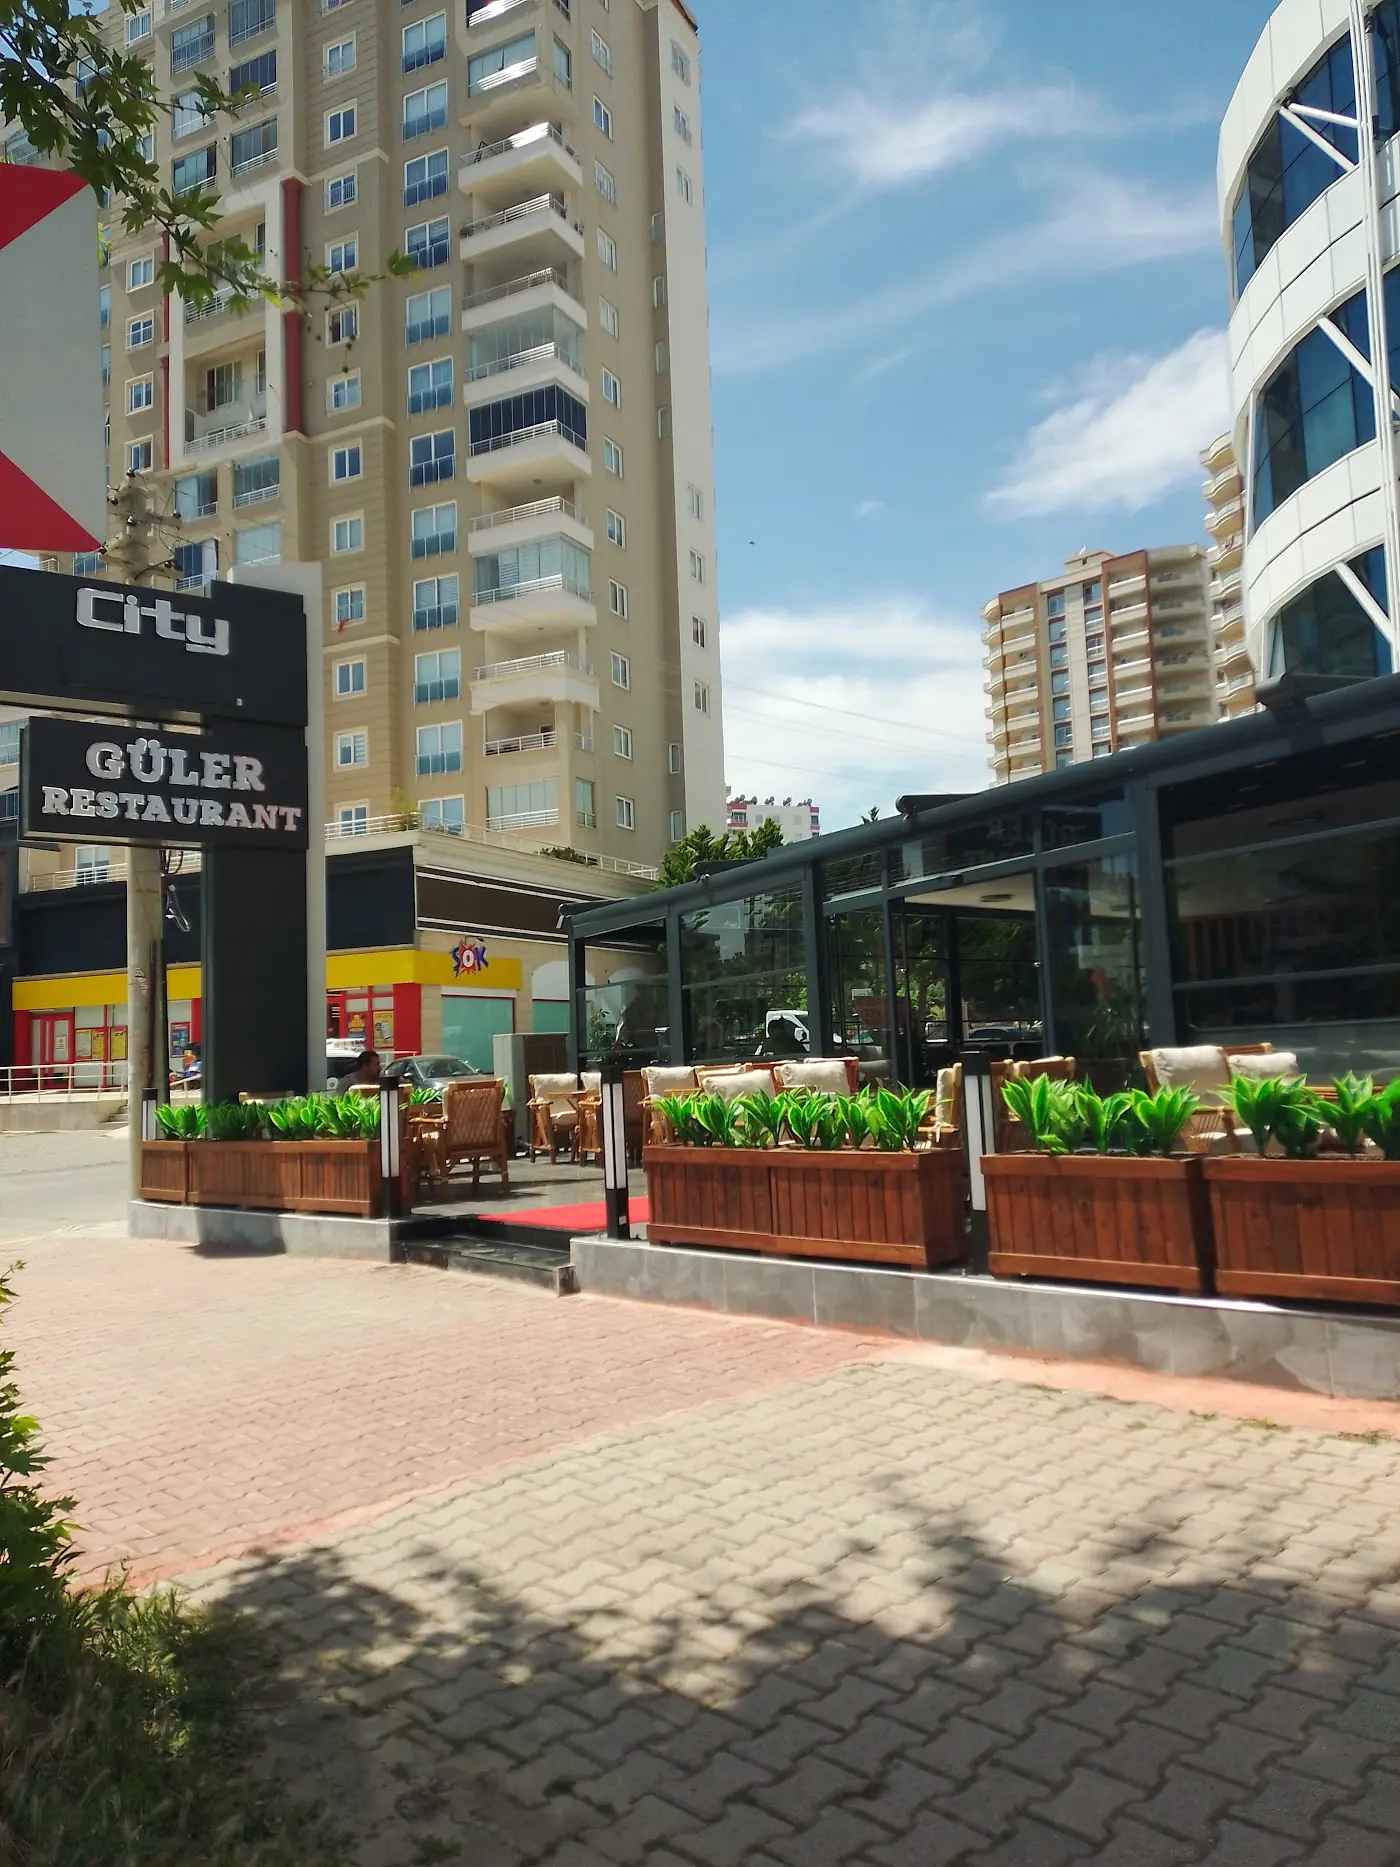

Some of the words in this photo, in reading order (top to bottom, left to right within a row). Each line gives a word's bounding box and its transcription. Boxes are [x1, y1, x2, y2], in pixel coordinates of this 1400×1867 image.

[76, 587, 229, 655] City
[85, 737, 266, 792] GÜLER
[41, 785, 302, 832] RESTAURANT
